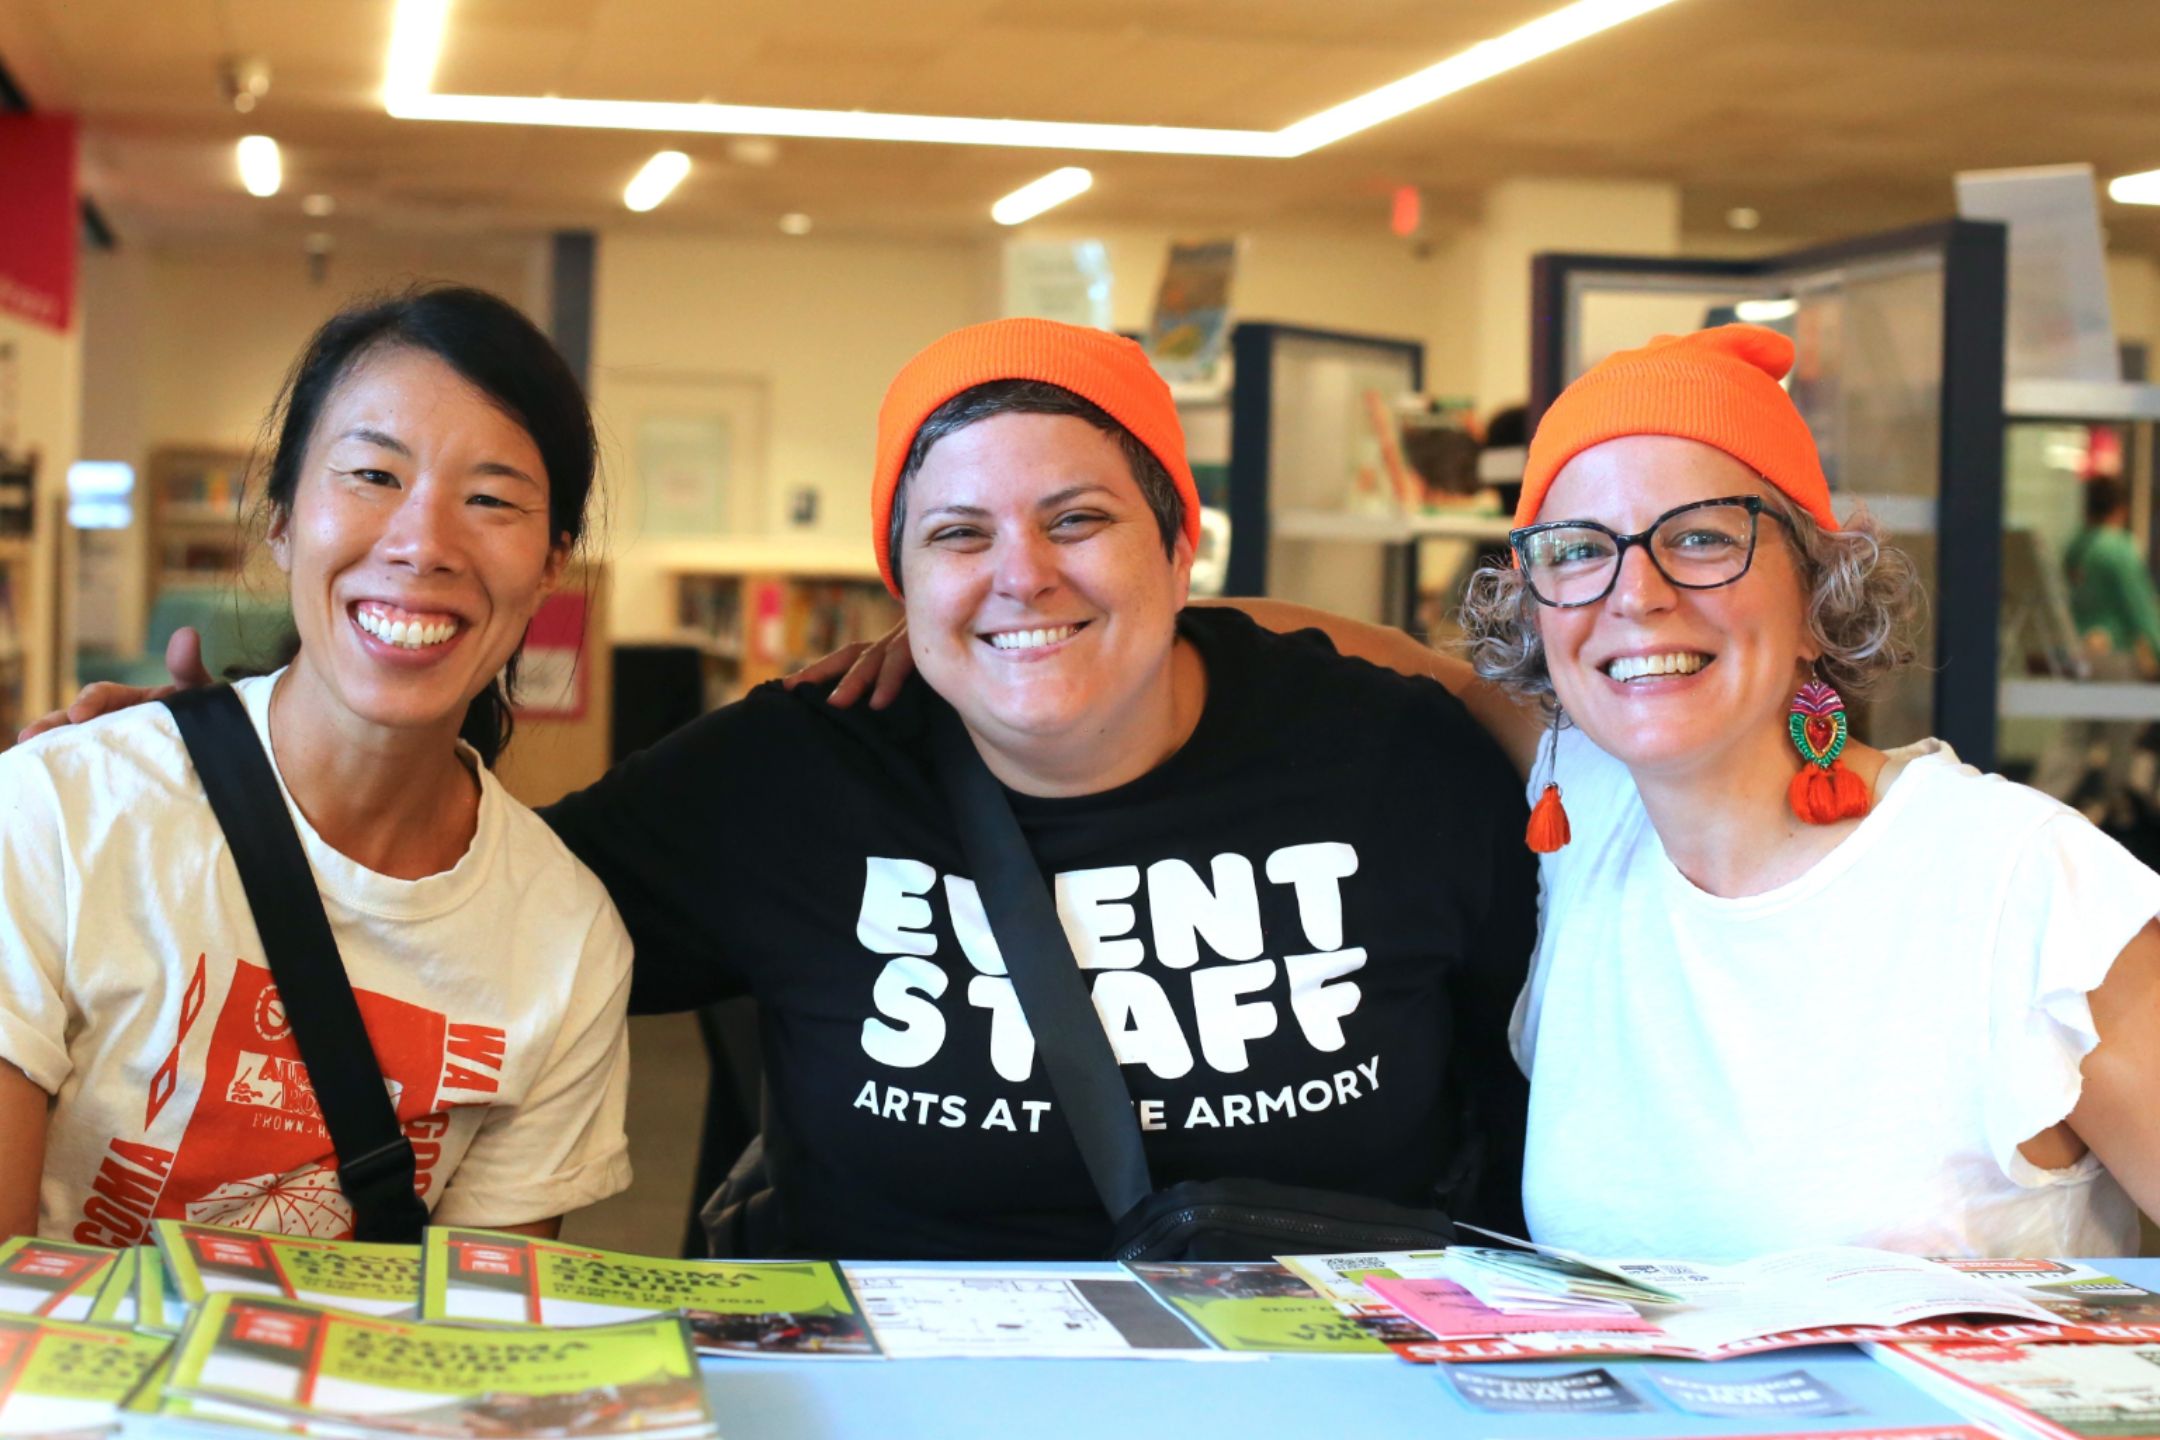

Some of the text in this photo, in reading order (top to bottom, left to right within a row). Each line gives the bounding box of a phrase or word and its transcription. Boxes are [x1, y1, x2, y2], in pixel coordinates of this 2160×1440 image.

[861, 947, 1367, 1082] STAFF
[853, 1080, 967, 1129] ARTS
[981, 1099, 1051, 1133] AT
[1184, 1055, 1380, 1130] ARMORY
